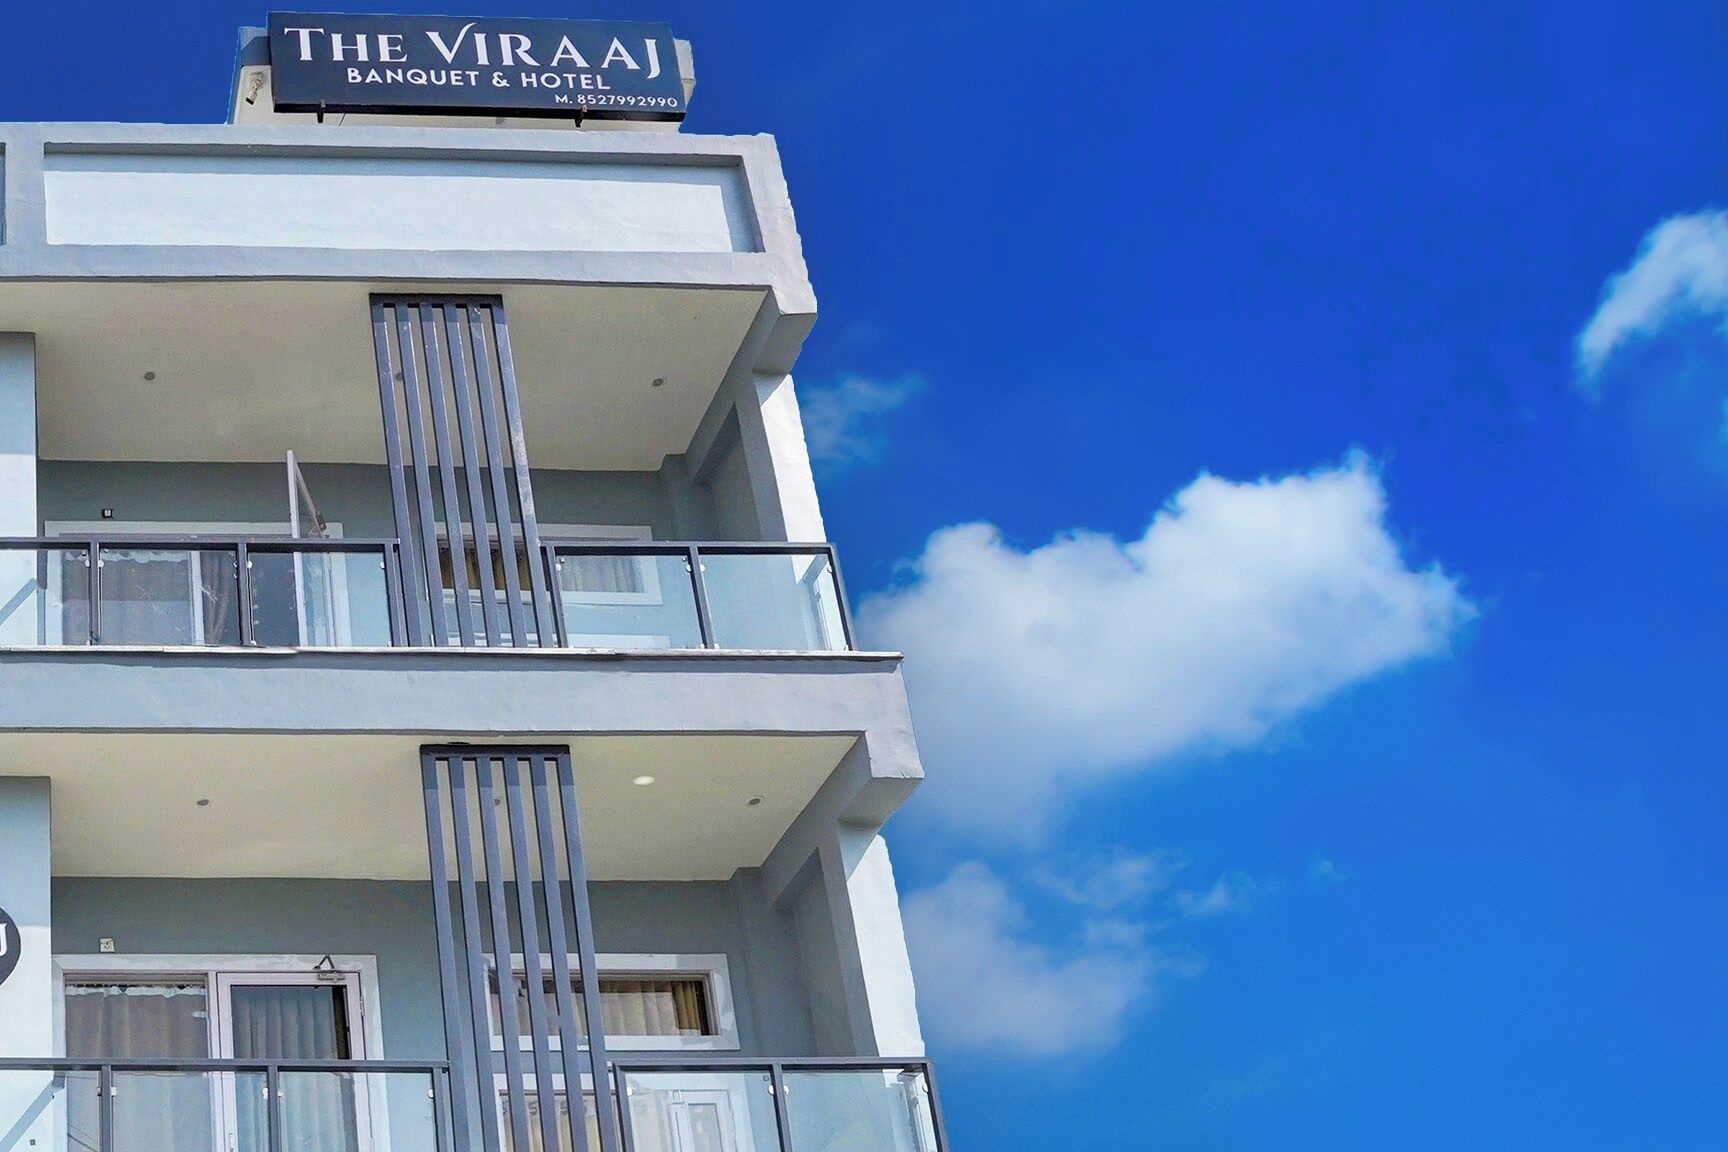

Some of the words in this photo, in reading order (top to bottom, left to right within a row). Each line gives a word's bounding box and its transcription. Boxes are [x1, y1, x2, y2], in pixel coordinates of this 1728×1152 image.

[284, 27, 408, 62] THE
[425, 22, 661, 79] VIRAAJ
[347, 67, 479, 86] BANQUET
[491, 71, 510, 88] &
[521, 72, 611, 90] HOTEL
[555, 94, 573, 104] M.
[577, 94, 678, 107] 8527992990
